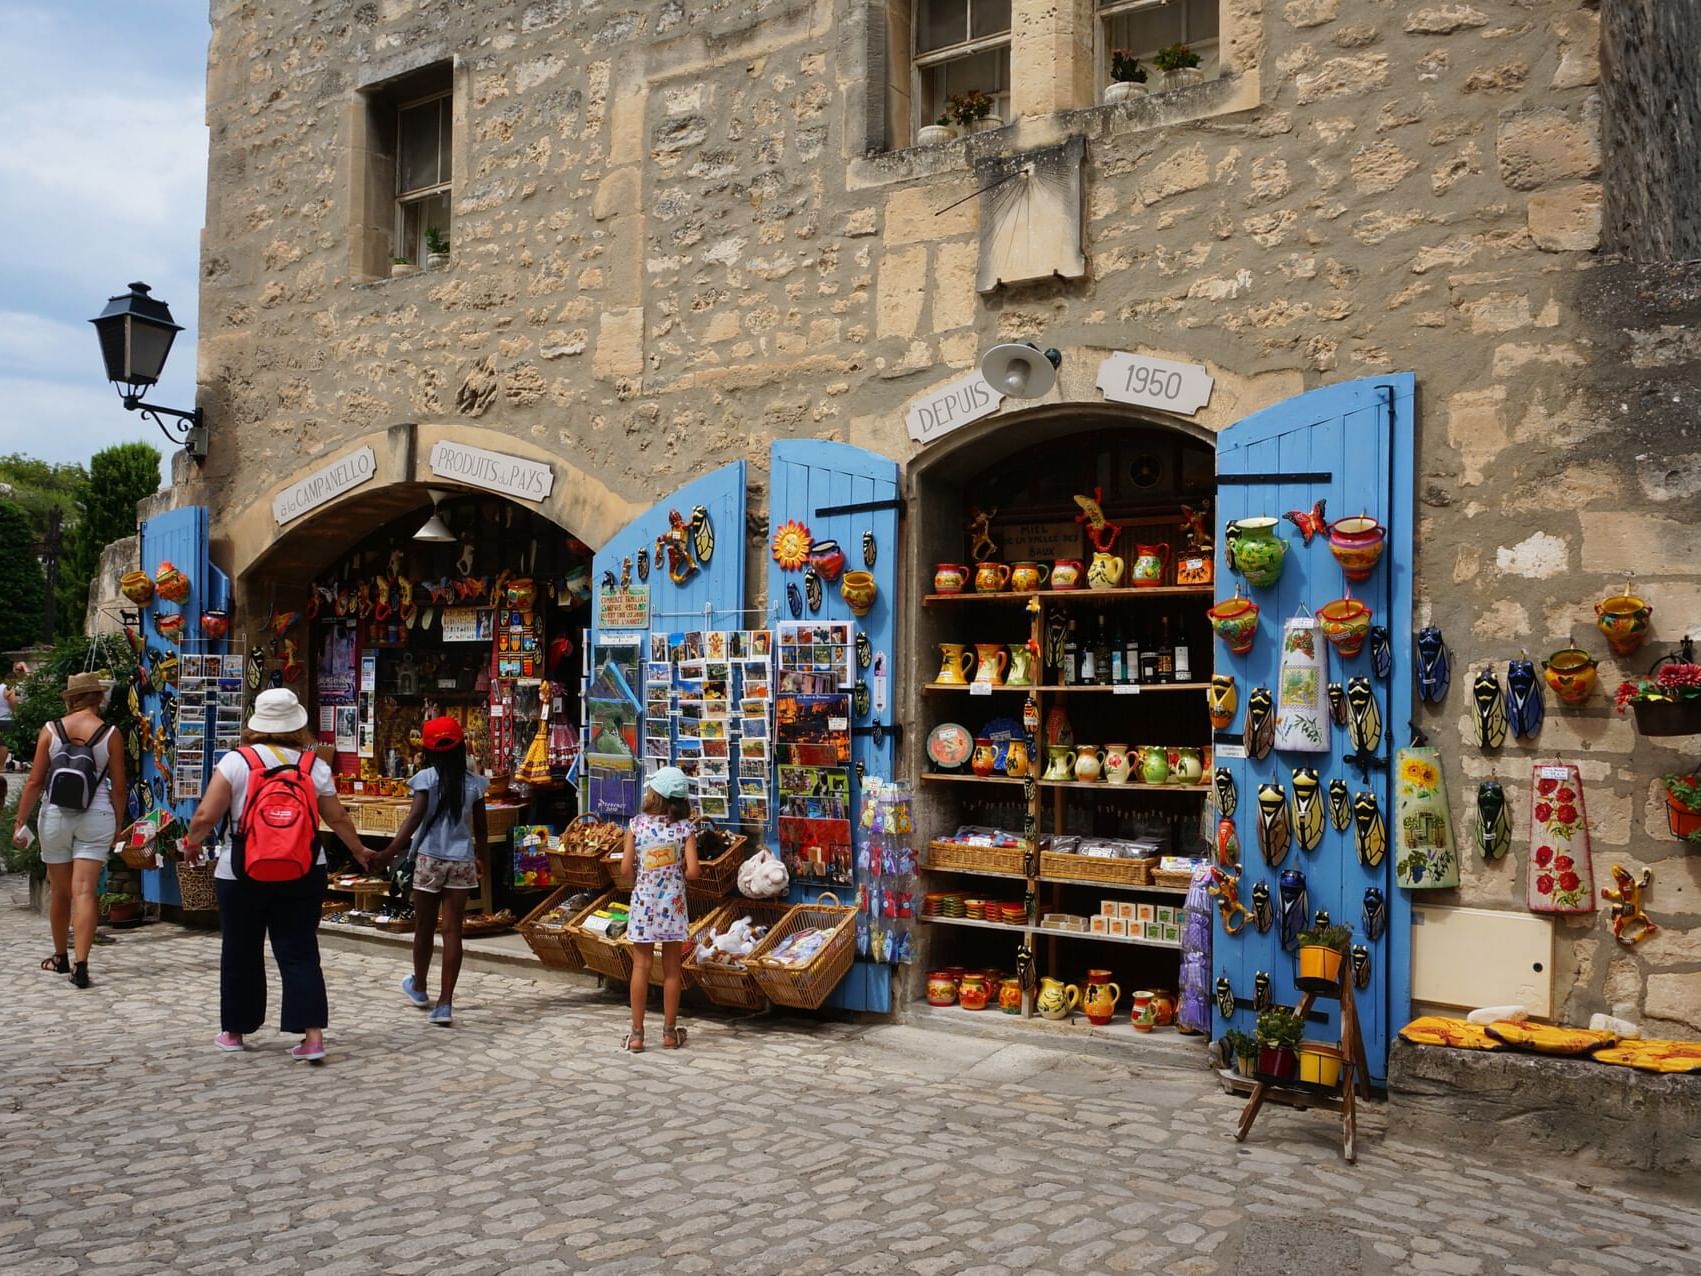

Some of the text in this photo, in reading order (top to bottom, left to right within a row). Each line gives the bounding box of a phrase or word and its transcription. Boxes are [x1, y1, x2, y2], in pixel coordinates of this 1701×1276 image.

[918, 380, 990, 433] DEPUIS
[1125, 364, 1182, 399] 1950
[287, 502, 296, 513] la
[295, 454, 370, 507] CAMPANELLO
[438, 447, 500, 482] PRODUITS
[509, 465, 545, 494] PAYS
